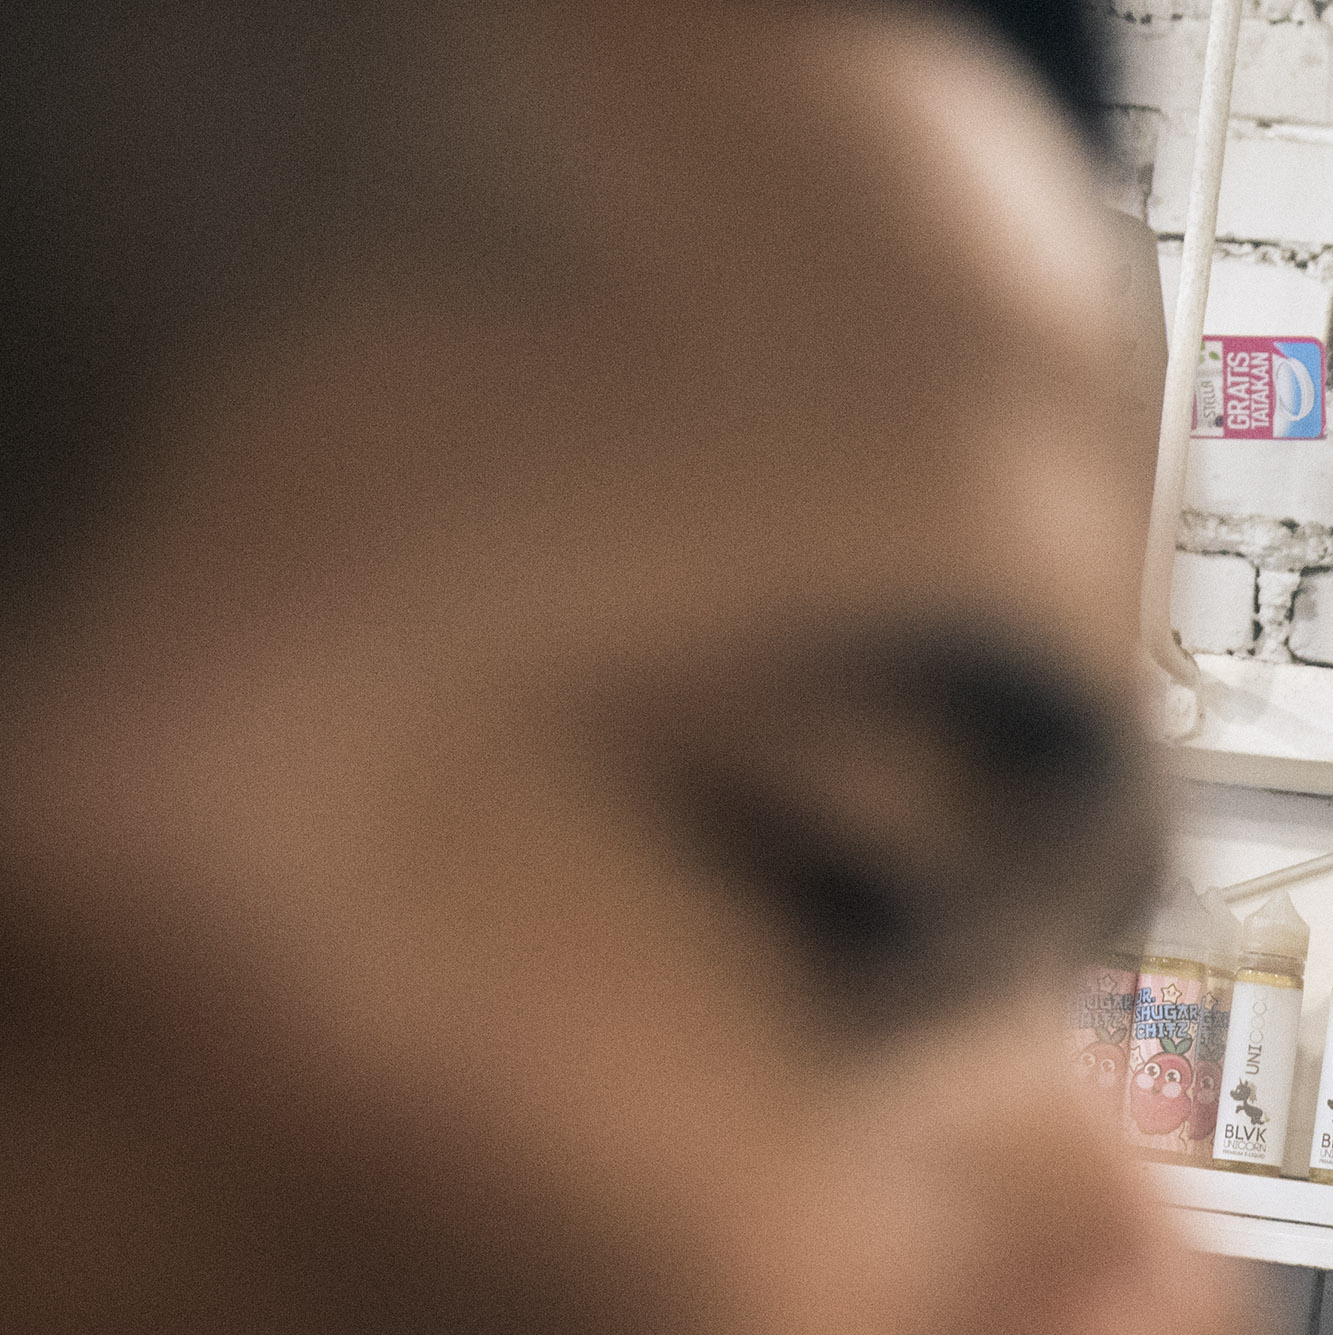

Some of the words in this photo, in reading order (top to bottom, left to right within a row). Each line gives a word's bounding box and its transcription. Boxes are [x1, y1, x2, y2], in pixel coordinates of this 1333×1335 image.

[1226, 351, 1250, 430] GRATIS
[1250, 351, 1270, 430] TATAKAN
[1135, 1021, 1189, 1040] CHITZ
[1224, 1123, 1267, 1143] BLVK
